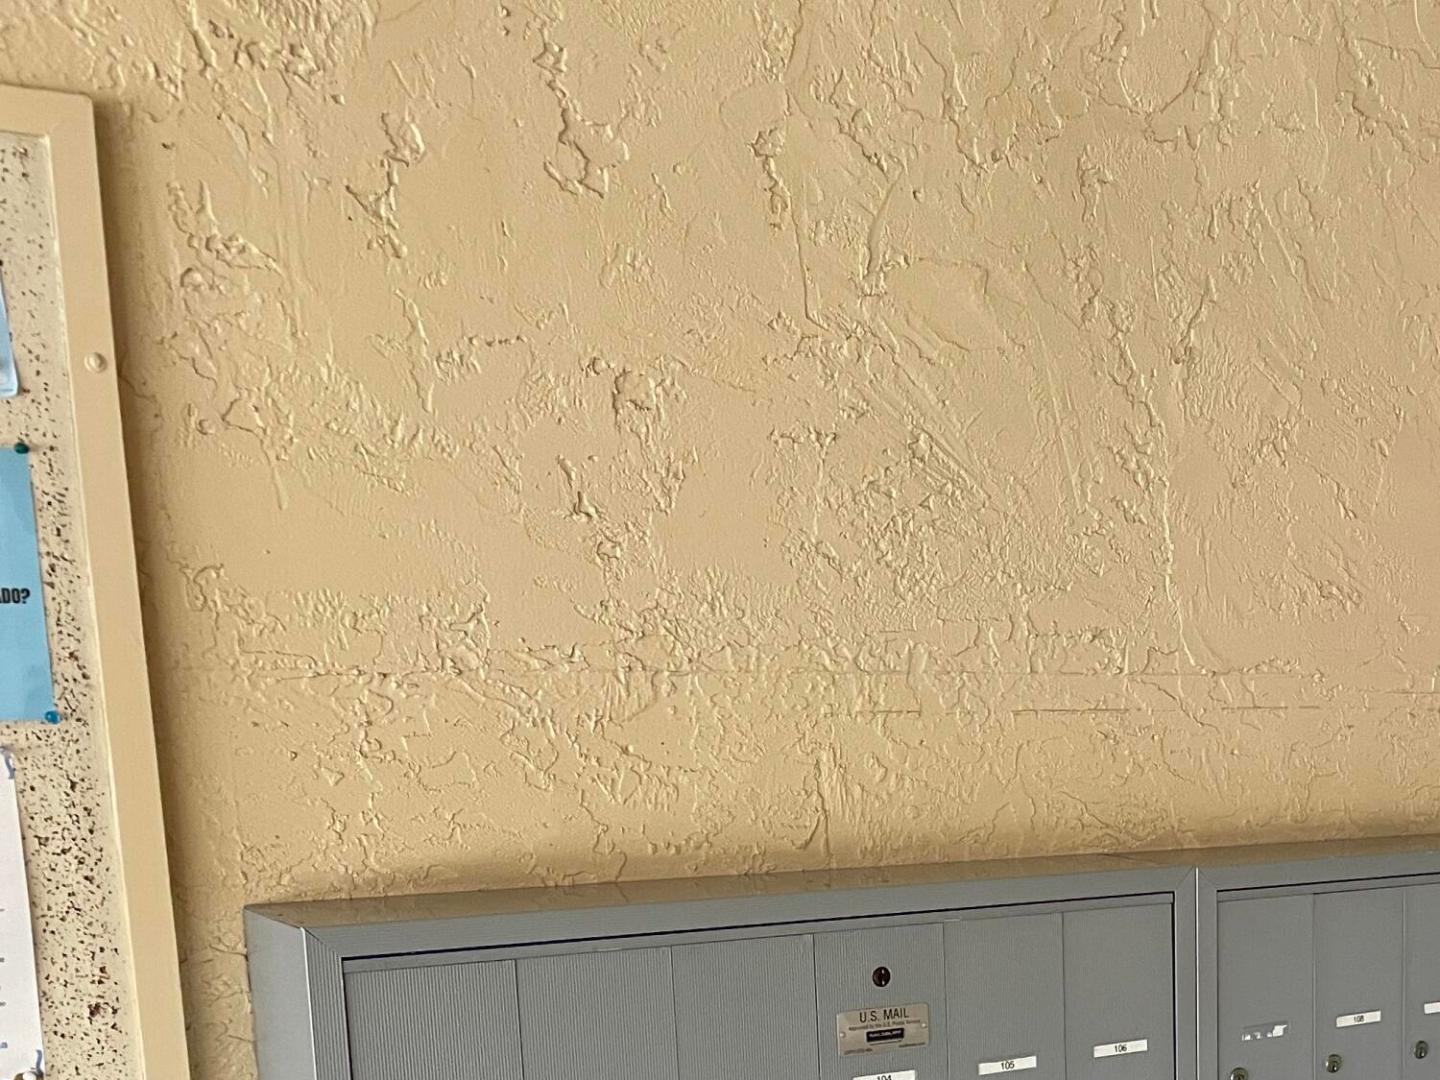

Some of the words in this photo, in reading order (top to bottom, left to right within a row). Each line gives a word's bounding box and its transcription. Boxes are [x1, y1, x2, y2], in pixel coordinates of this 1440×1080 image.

[0, 587, 31, 605] DO?
[859, 1010, 881, 1023] U.S.
[883, 1007, 910, 1020] MAIL
[1114, 1043, 1127, 1053] 106
